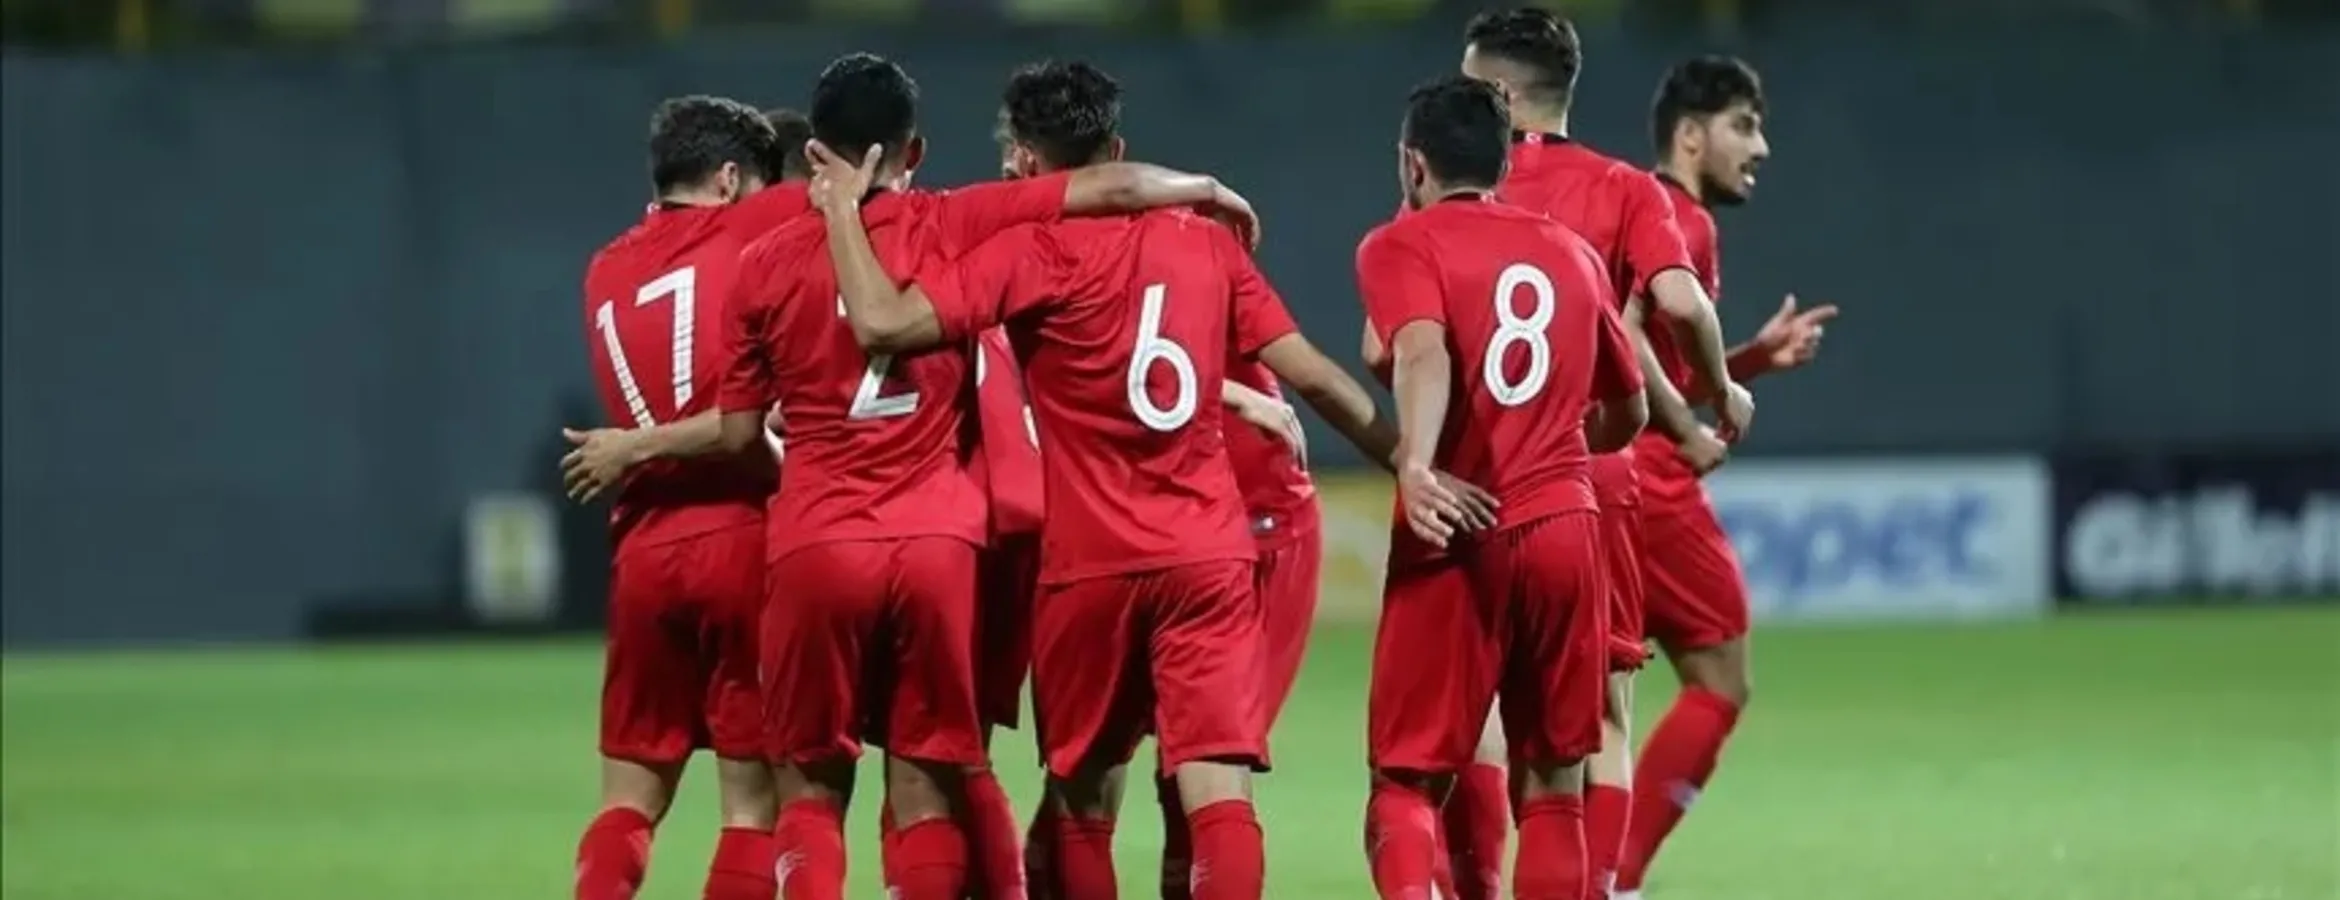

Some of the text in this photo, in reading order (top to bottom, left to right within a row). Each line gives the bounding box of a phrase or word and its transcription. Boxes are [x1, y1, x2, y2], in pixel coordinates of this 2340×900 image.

[596, 266, 695, 428] 17
[1127, 283, 1197, 431] 6
[1484, 264, 1556, 407] 8
